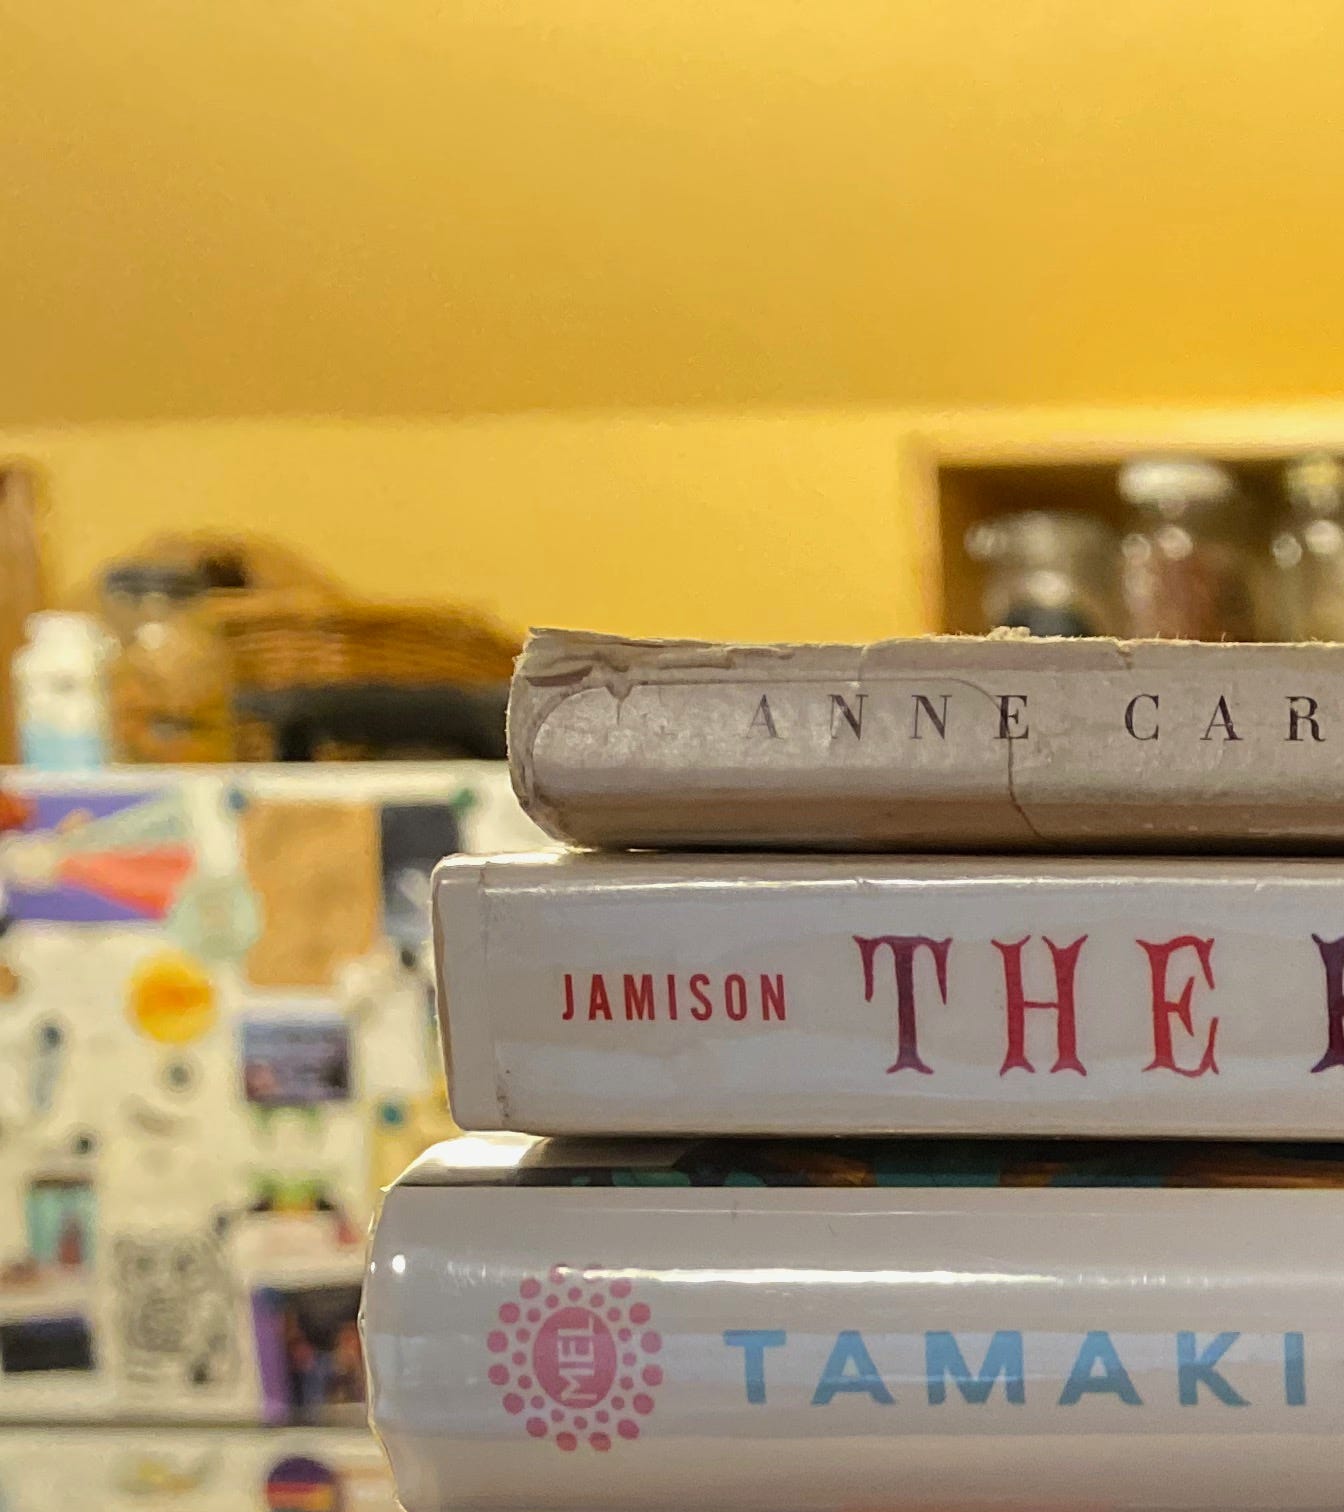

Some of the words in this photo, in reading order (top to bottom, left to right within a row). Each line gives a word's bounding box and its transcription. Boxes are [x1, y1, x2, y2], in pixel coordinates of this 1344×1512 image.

[745, 691, 1030, 744] ANNE
[560, 971, 788, 1023] JAMISON
[851, 932, 1219, 1078] THE
[722, 1329, 1307, 1408] TAMAKI
